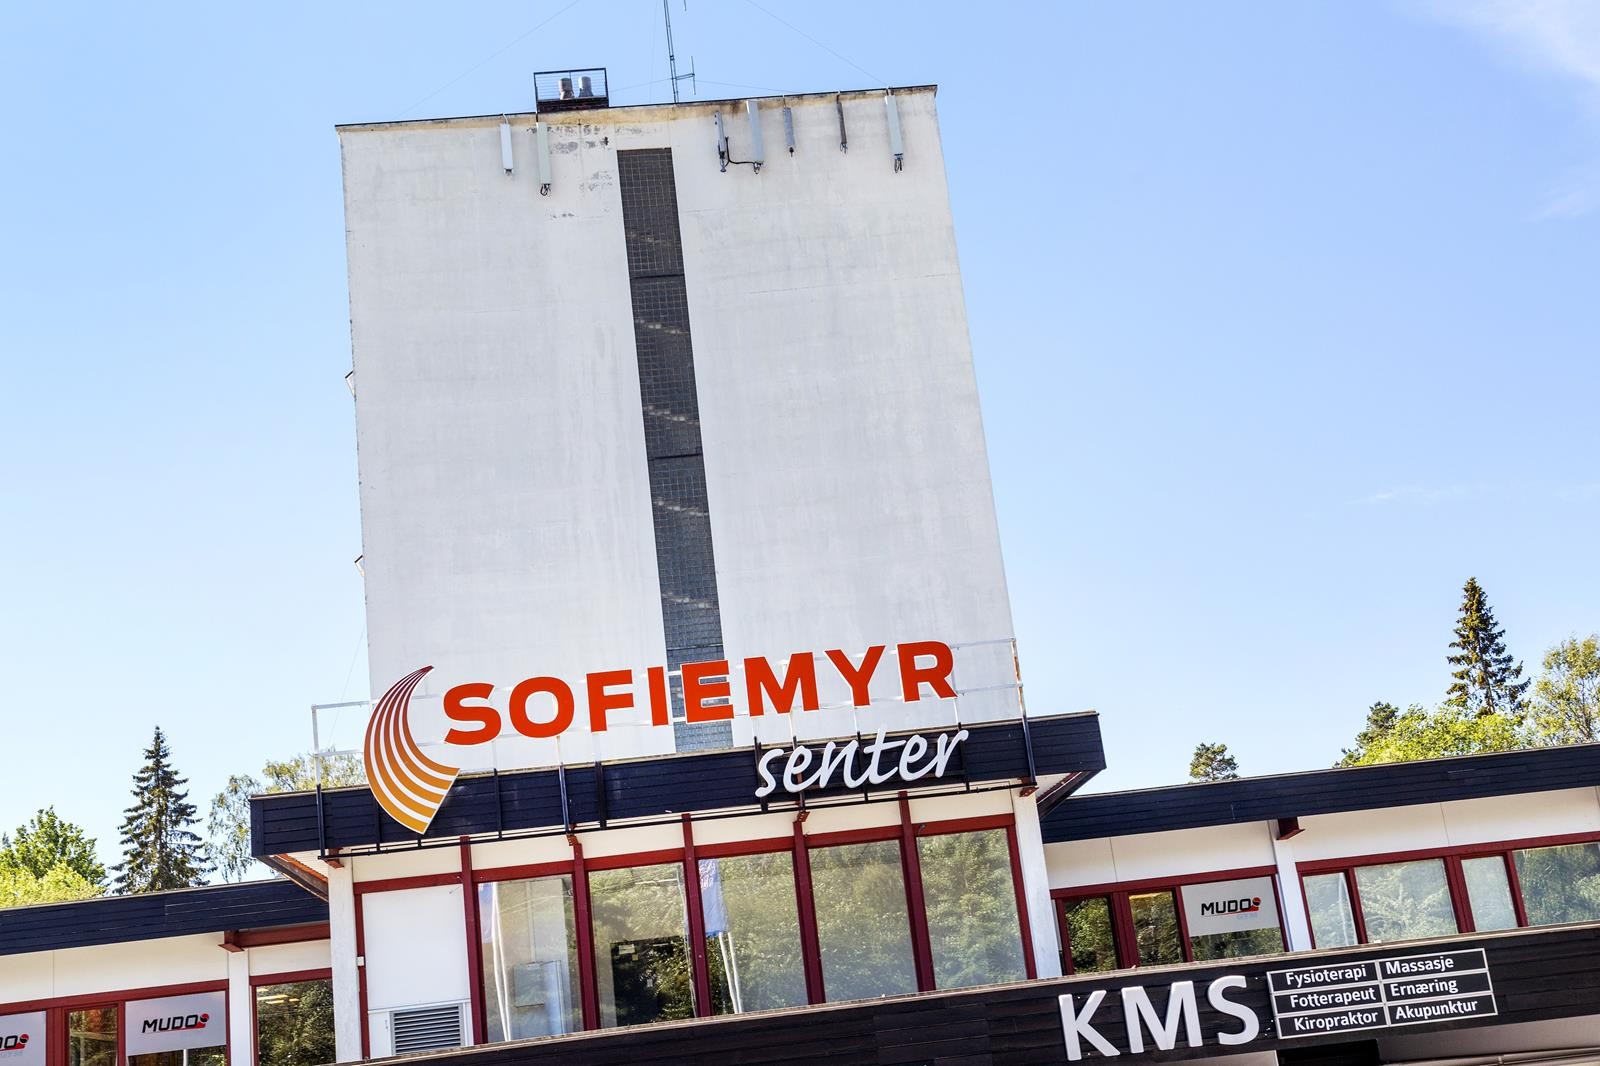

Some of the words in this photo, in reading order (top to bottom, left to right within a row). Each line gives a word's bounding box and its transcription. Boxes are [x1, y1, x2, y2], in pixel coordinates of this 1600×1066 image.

[442, 641, 956, 746] SOFIEMYR
[755, 727, 969, 798] senter
[1201, 898, 1252, 916] MUDO
[1385, 956, 1454, 975] Massasje
[1285, 966, 1367, 988] Fysioterapi
[1289, 986, 1377, 1008] Fotterapeut
[1389, 978, 1459, 998] Ernæring
[1058, 975, 1261, 1061] KMS
[1395, 1000, 1478, 1020] Akupunktur
[141, 1014, 199, 1034] MUDO
[1293, 1011, 1379, 1032] Kiropraktor
